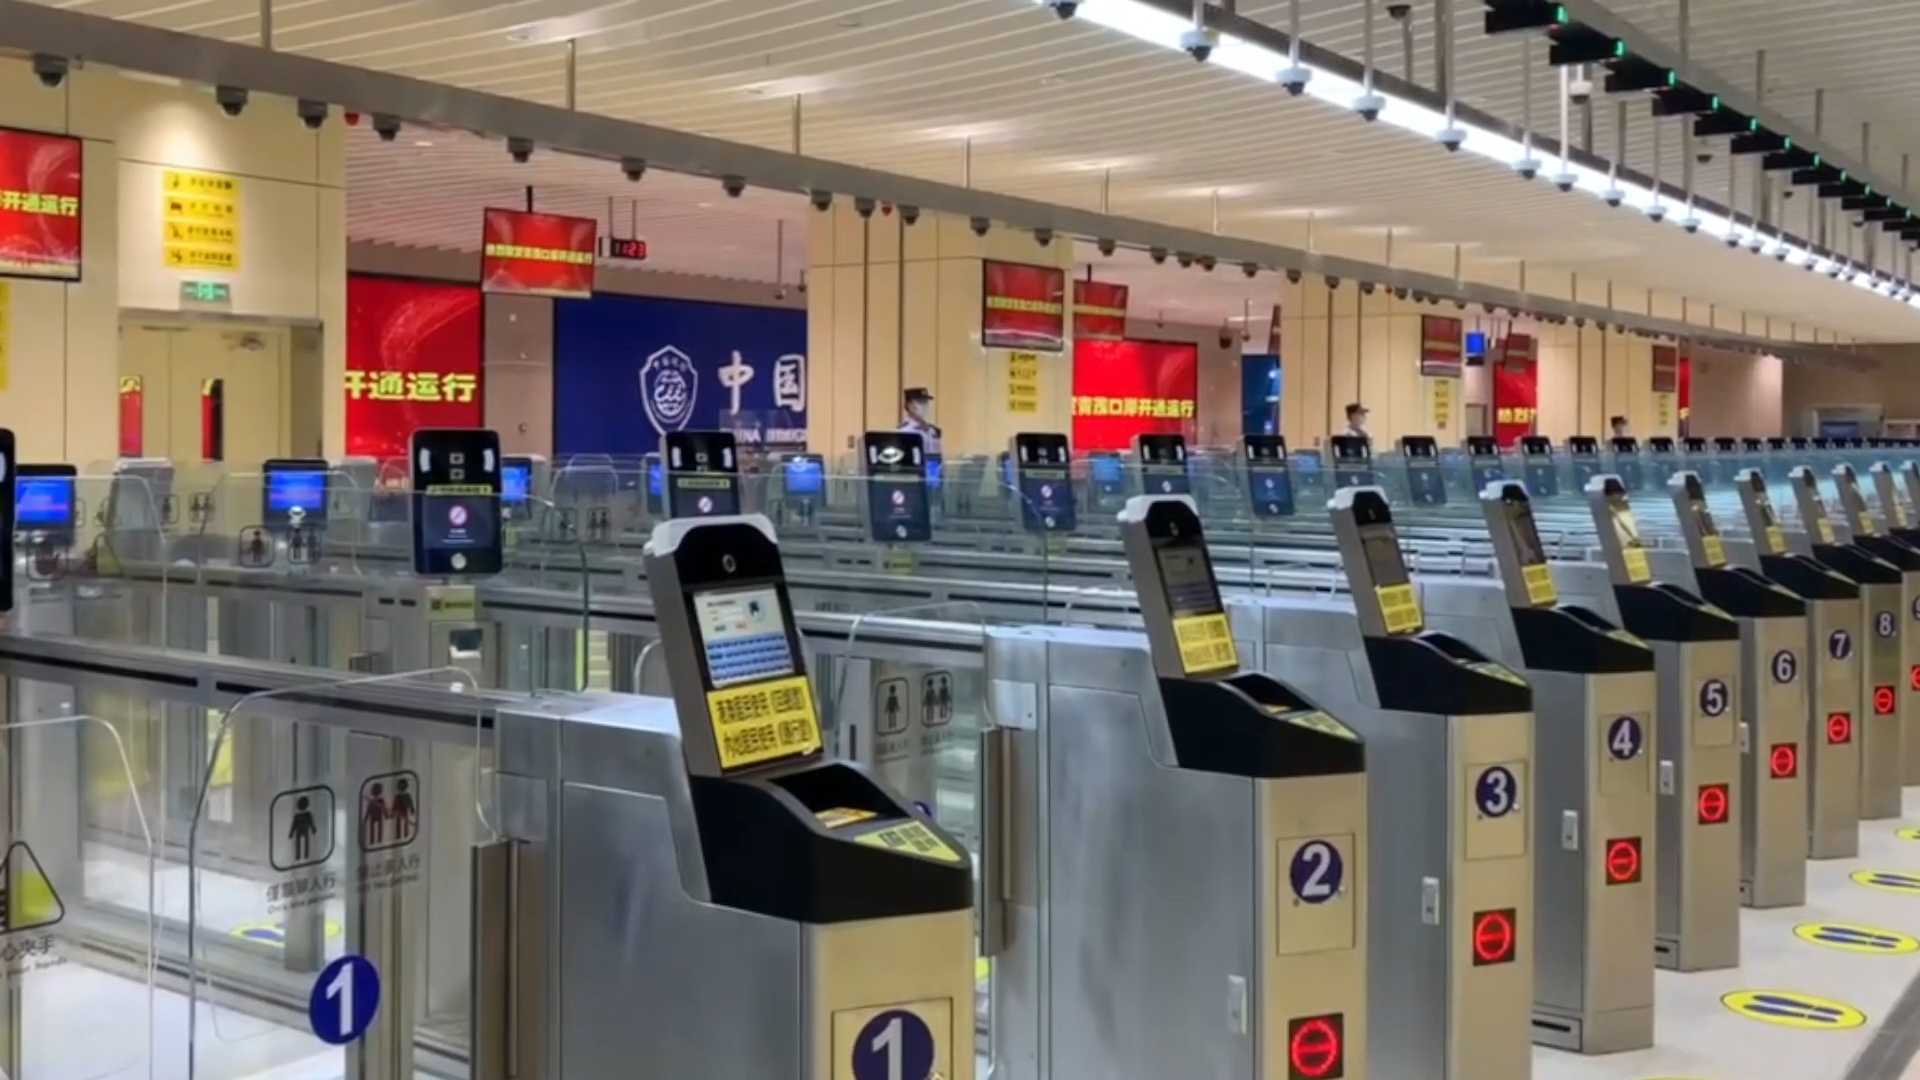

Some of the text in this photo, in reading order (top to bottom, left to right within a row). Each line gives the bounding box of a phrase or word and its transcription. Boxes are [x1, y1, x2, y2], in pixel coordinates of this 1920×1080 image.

[0, 190, 78, 216] 开通运行
[1073, 396, 1194, 418] 青茂口岸开通运行
[1879, 613, 1891, 636] 8
[1833, 633, 1847, 657] 7
[1777, 653, 1792, 681] 6
[1706, 682, 1723, 714] 5
[1612, 720, 1633, 756] 4
[1485, 770, 1508, 815] 3
[1302, 843, 1331, 897] 2
[326, 962, 353, 1036] 1
[872, 1017, 903, 1080] 1
